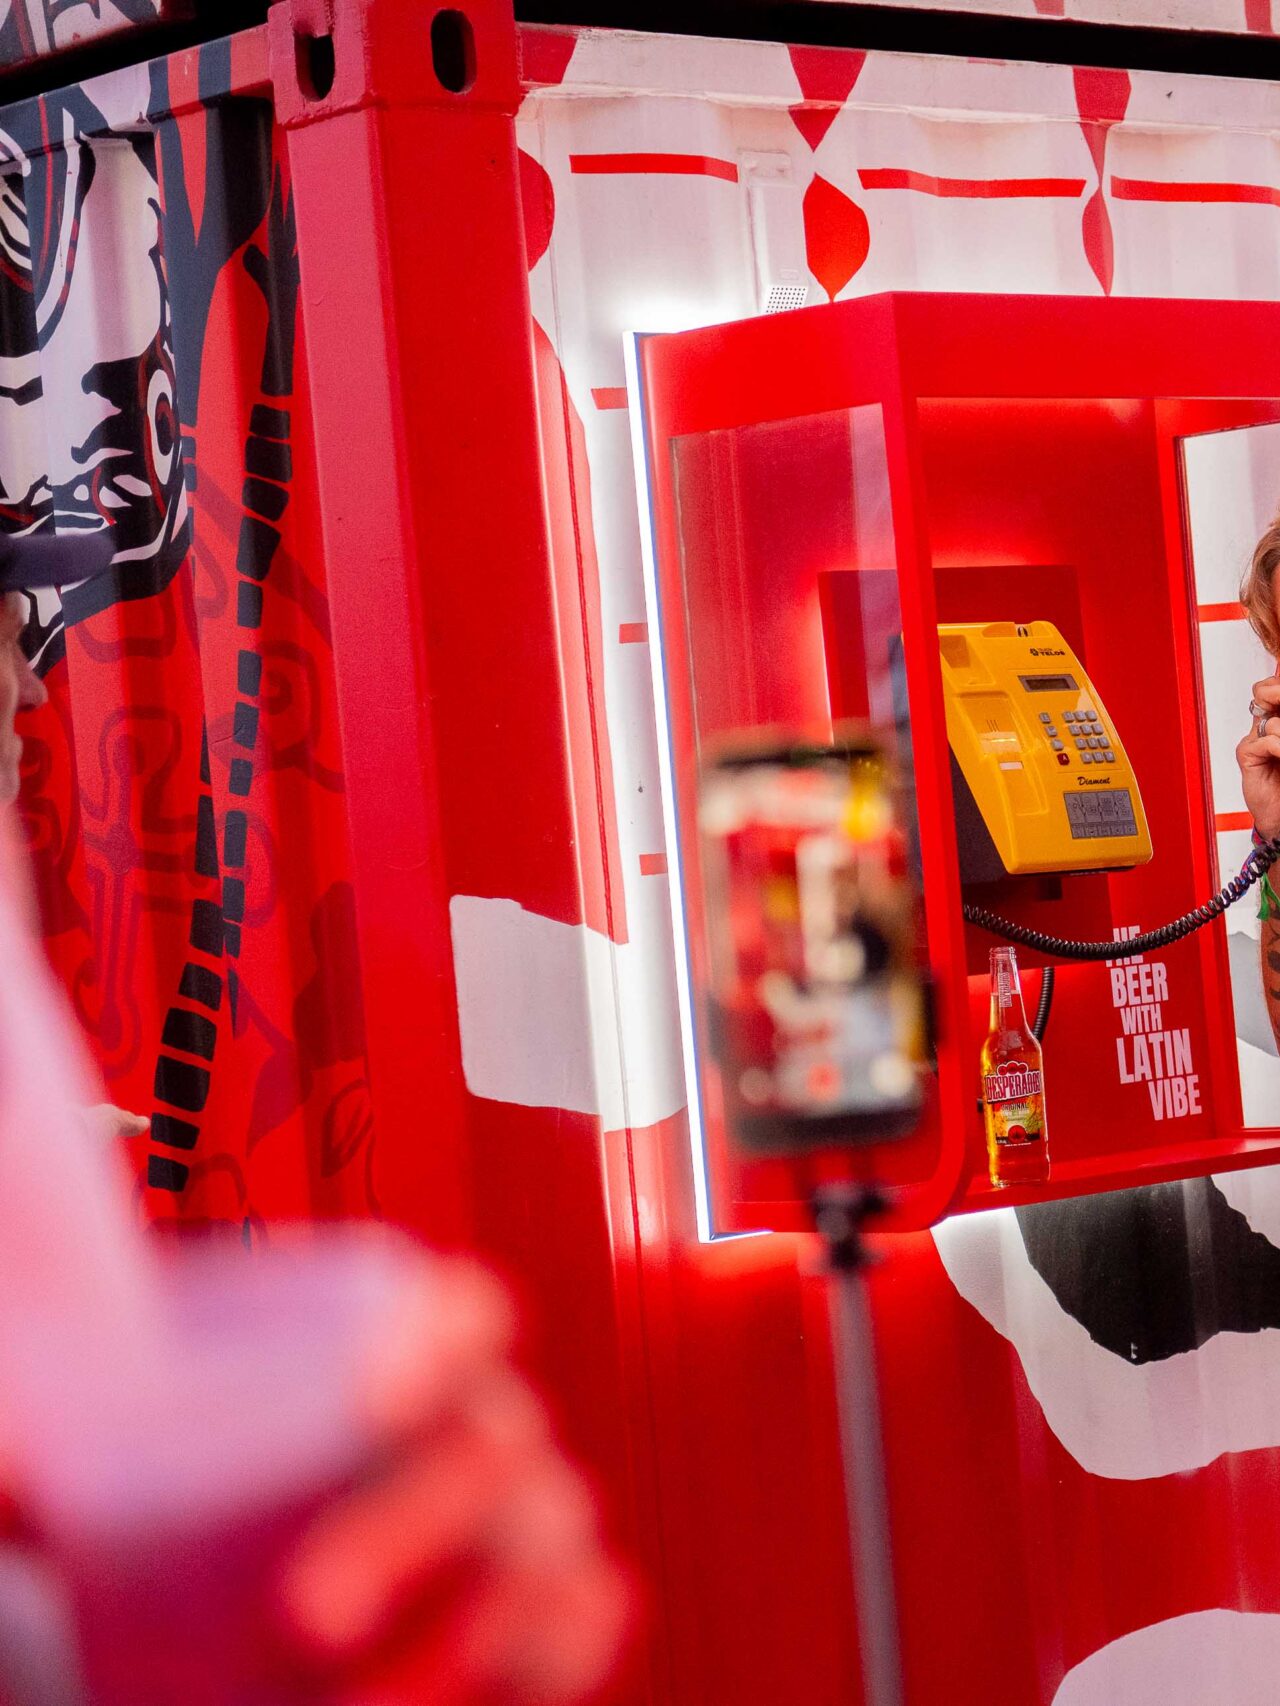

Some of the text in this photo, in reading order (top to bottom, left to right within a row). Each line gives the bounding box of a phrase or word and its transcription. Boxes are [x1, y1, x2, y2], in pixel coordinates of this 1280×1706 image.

[1110, 962, 1169, 1008] BEER
[1120, 1003, 1163, 1036] WITH
[1116, 1028, 1194, 1085] LATIN
[1148, 1074, 1203, 1121] VIBE
